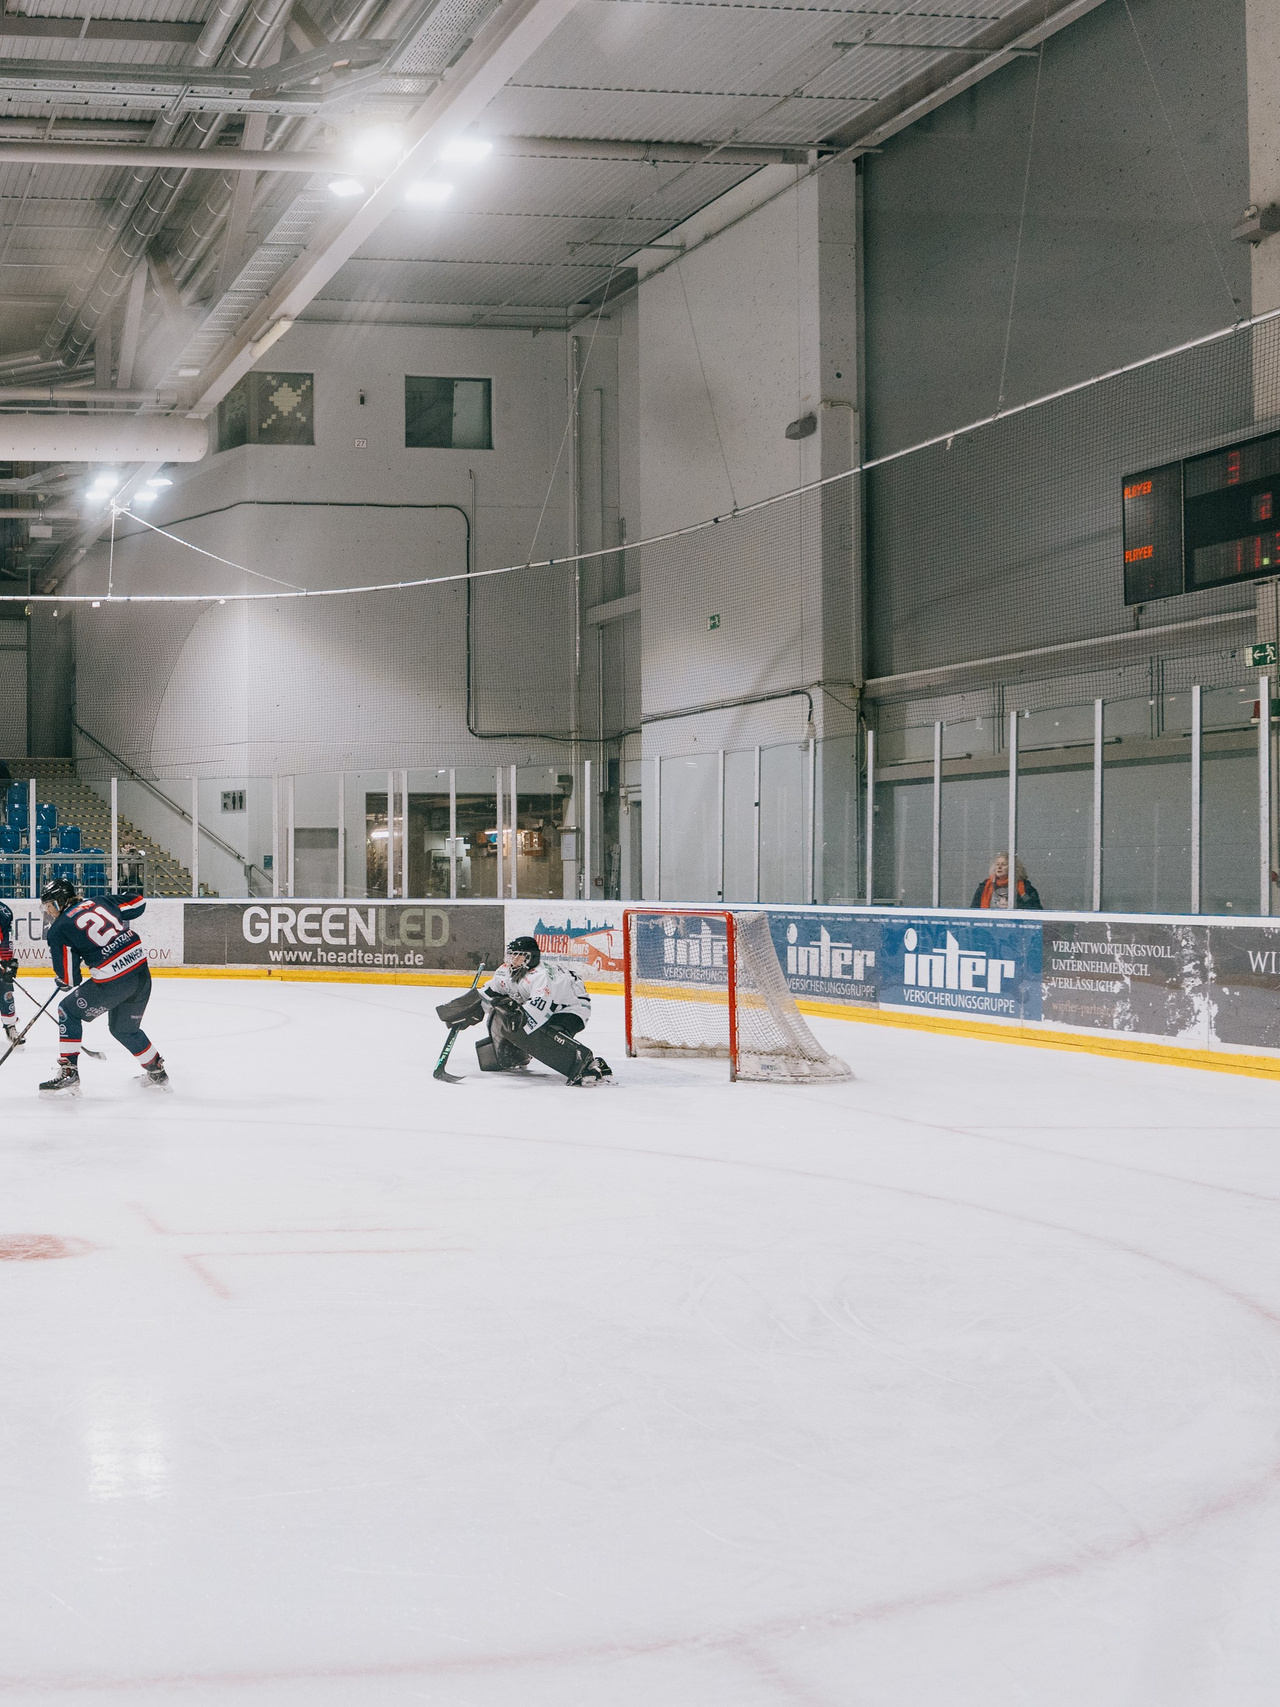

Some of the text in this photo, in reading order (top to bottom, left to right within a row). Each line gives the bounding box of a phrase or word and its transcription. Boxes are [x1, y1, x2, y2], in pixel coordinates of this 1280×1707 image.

[1124, 481, 1152, 499] PLAYER
[1125, 545, 1153, 563] PLAYER
[76, 906, 125, 947] 21
[269, 948, 424, 966] www.headteam.de
[786, 922, 875, 981] inter
[1052, 940, 1176, 959] VERANTWORTUNGSVOLL.
[904, 928, 1016, 994] inter
[1051, 959, 1151, 977] UNTERNEHMERISCH.
[1247, 950, 1280, 974] WI
[786, 977, 876, 998] VERSICHERUNGSGRUPPE
[530, 996, 547, 1012] 30
[903, 988, 1016, 1014] VERSICHERUNGSGRUPPE
